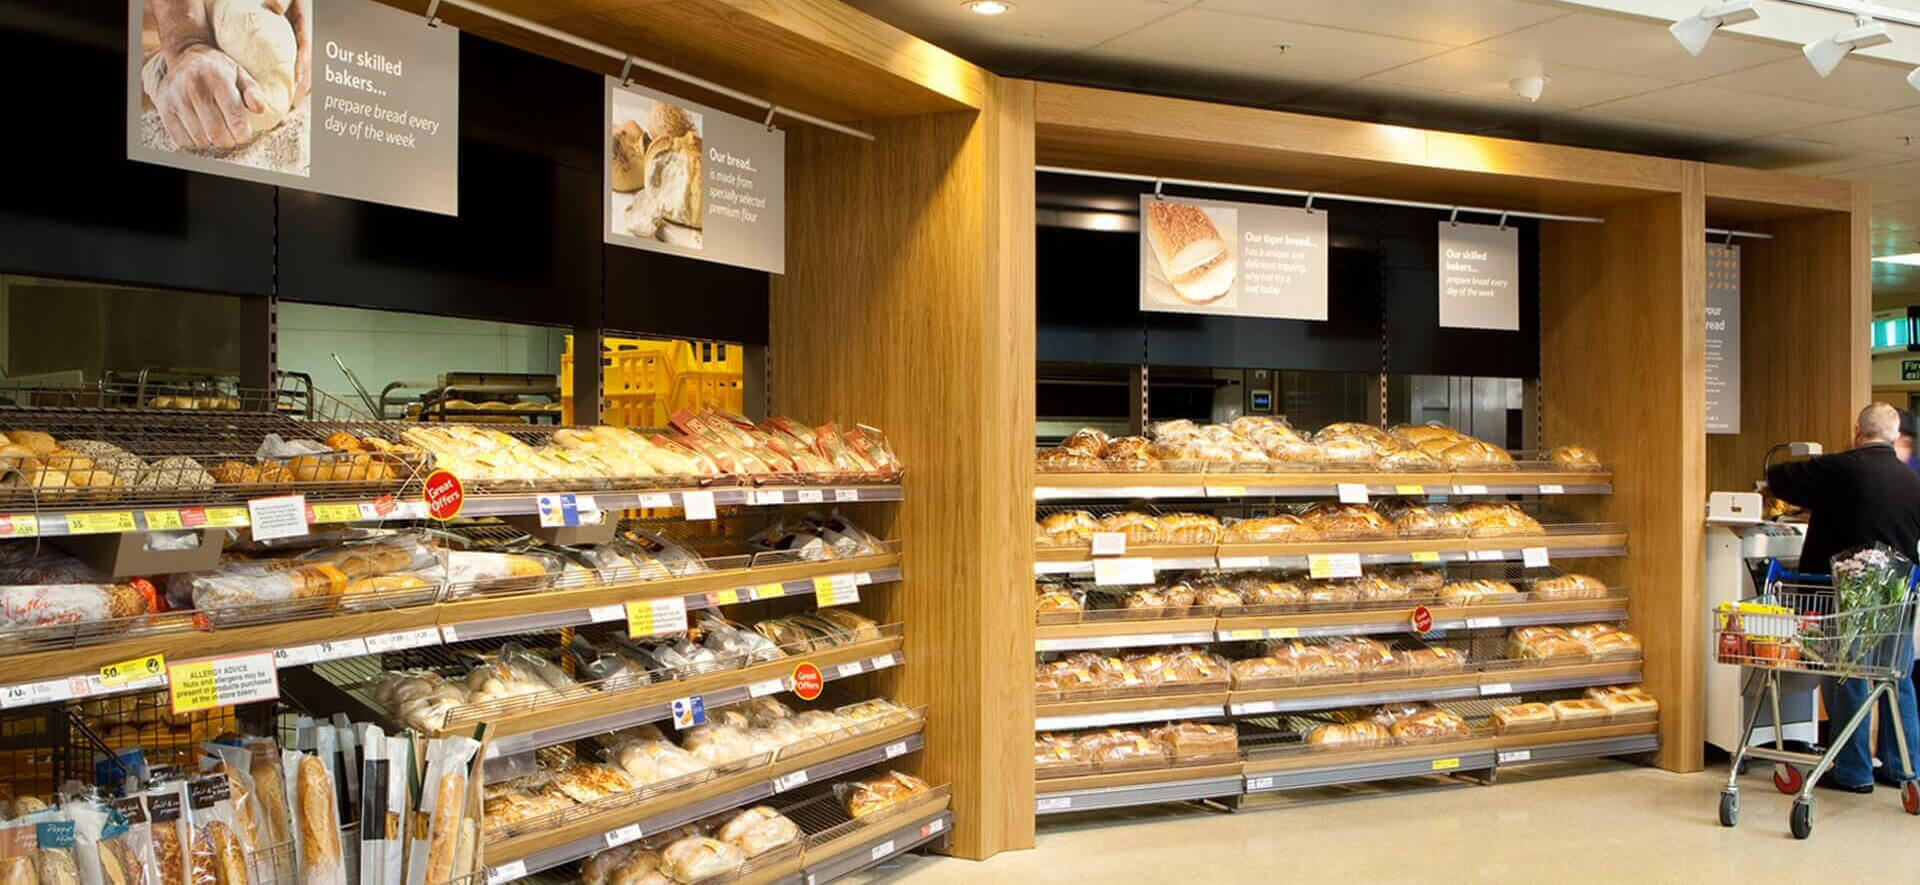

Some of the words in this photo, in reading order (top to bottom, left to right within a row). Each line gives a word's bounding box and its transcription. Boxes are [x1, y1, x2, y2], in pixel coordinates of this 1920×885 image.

[326, 41, 354, 63] Our
[357, 50, 402, 76] skilled
[325, 64, 386, 96] bakers...
[324, 95, 372, 117] prepare
[374, 104, 407, 125] bread
[409, 116, 440, 135] every
[325, 115, 347, 136] day
[349, 122, 363, 140] of
[365, 124, 384, 141] the
[386, 132, 416, 148] week
[709, 147, 726, 163] Our
[727, 152, 758, 172] bread...
[716, 172, 736, 186] made
[736, 174, 753, 190] from
[710, 187, 738, 204] specially
[739, 194, 766, 209] selected
[709, 204, 741, 219] premium
[741, 208, 758, 223] flour
[1245, 231, 1262, 242] Our
[1263, 235, 1284, 247] tiger
[1446, 248, 1461, 259] Our
[1462, 249, 1488, 261] skilled
[427, 479, 454, 500] Great
[431, 491, 460, 512] Offers
[190, 667, 223, 679] ALLERGY
[224, 664, 248, 674] ADVICE
[796, 671, 818, 681] Great
[176, 687, 205, 698] present
[241, 678, 272, 689] purchased
[183, 680, 199, 688] Nuts
[200, 678, 213, 687] and
[237, 687, 257, 698] bakery
[797, 680, 820, 691] Offers
